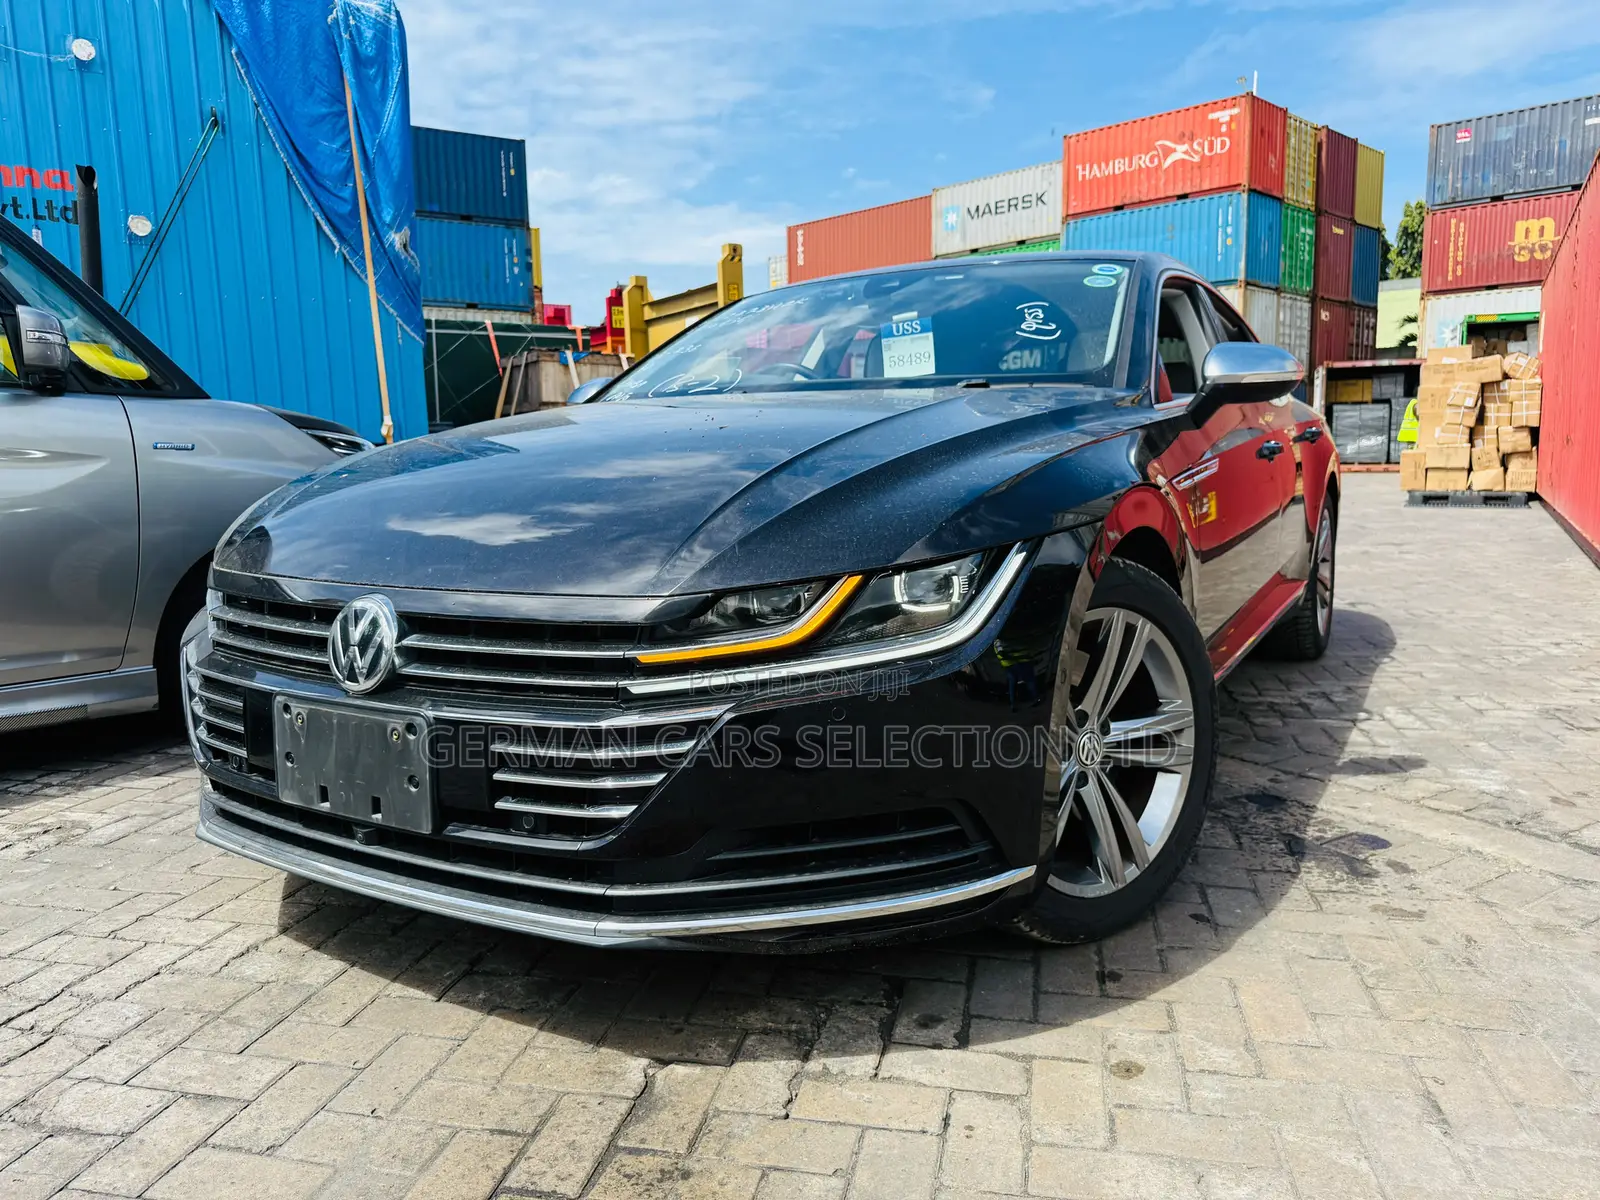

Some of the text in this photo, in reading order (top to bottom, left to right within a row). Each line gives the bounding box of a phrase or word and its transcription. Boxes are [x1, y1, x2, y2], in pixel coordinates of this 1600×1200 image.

[1076, 136, 1230, 182] HAMBURG SÜD
[967, 190, 1048, 220] MAERSK
[892, 319, 921, 336] USS
[888, 351, 931, 368] 58489
